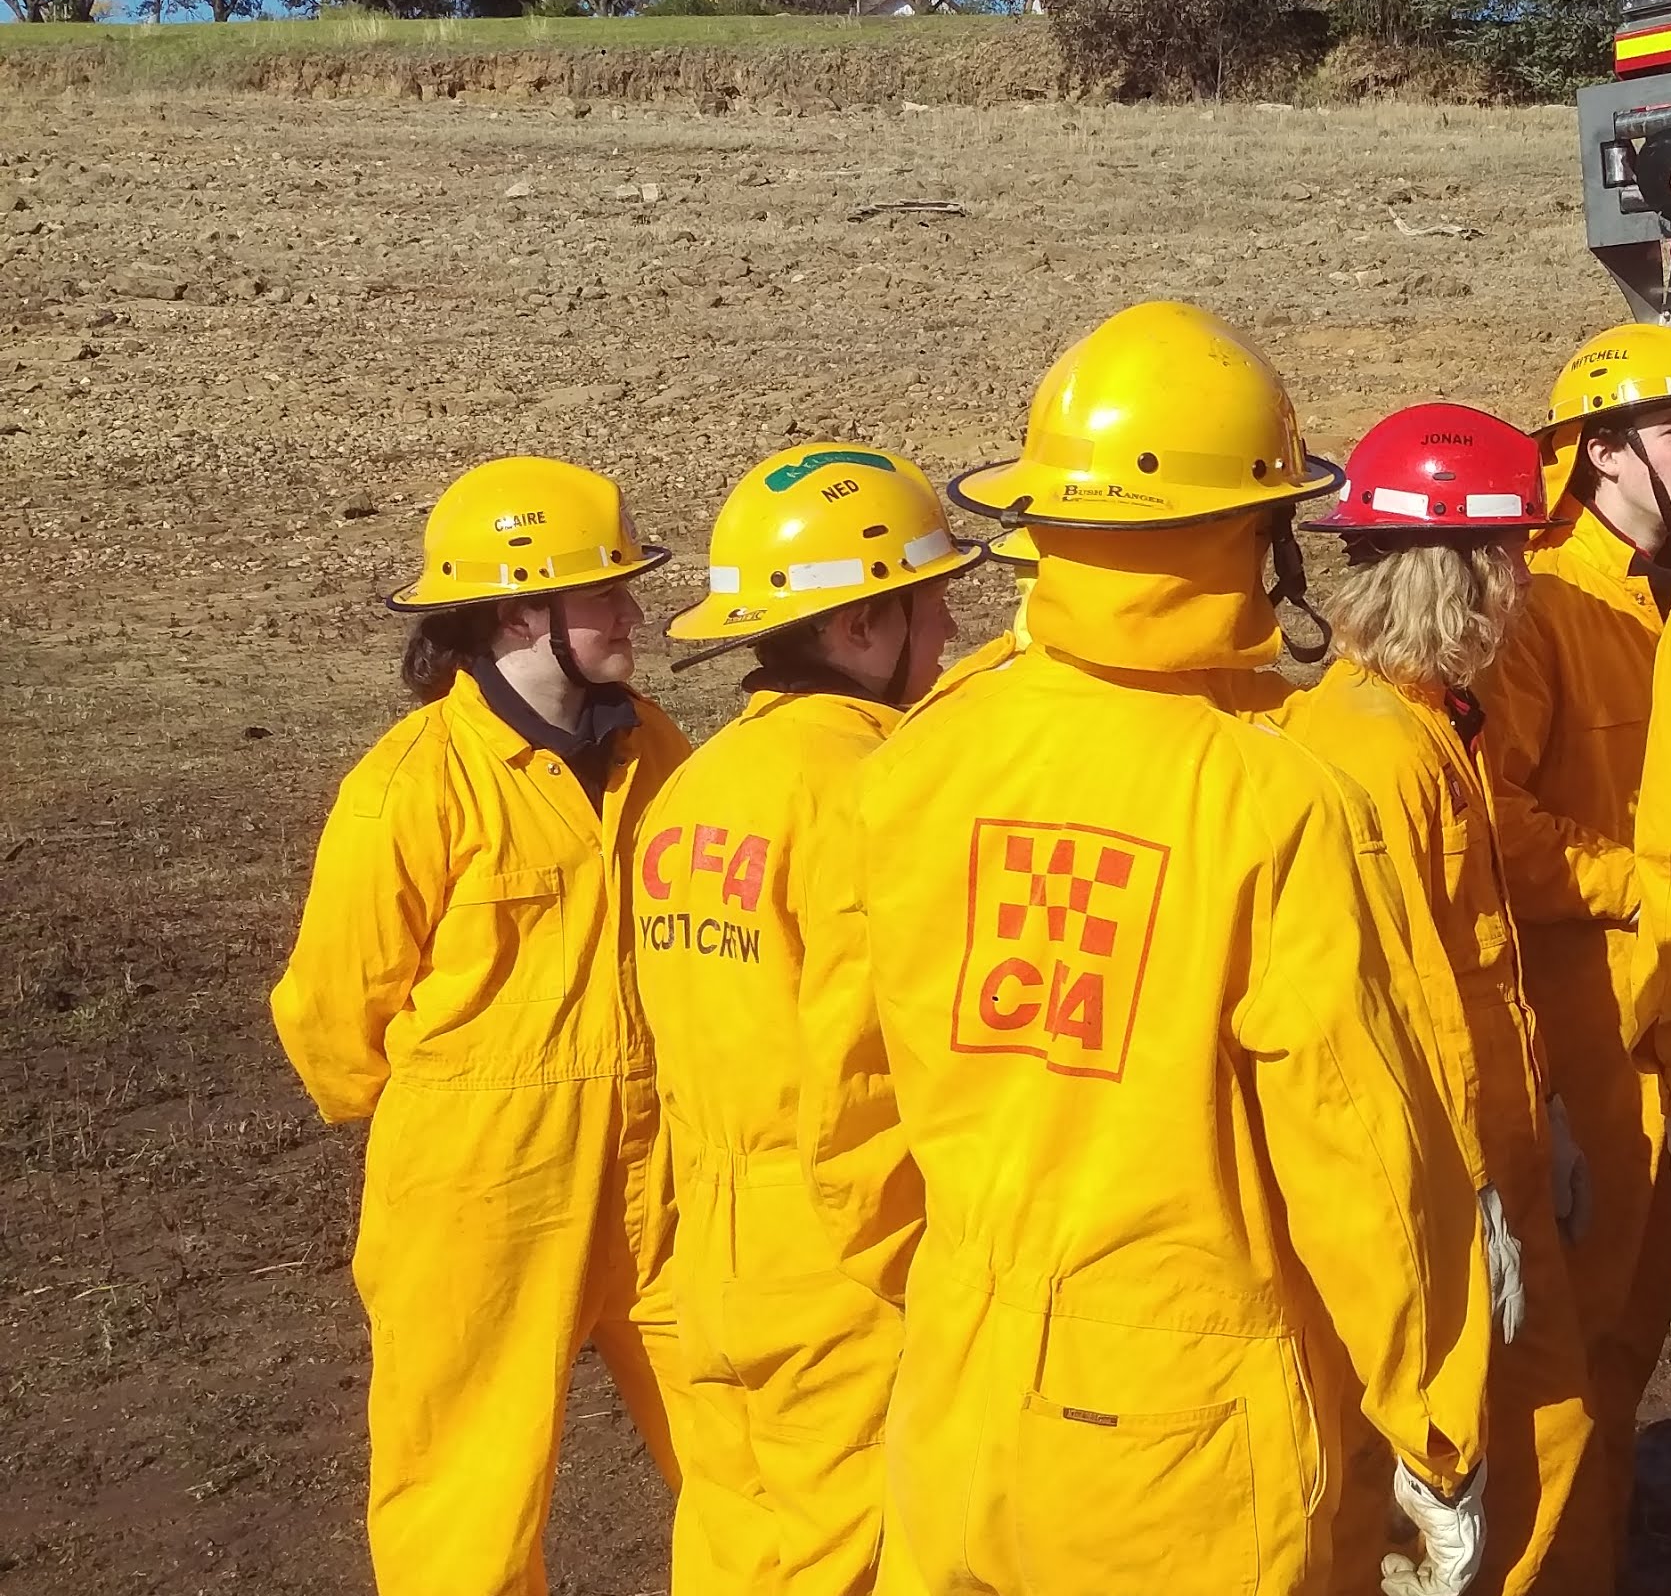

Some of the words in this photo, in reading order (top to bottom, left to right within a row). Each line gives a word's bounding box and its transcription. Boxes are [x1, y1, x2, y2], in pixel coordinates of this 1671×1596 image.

[1571, 349, 1629, 373] MITCHELL
[1420, 432, 1473, 447] JONAH
[820, 479, 861, 504] NED
[1106, 484, 1165, 505] RANGER
[494, 510, 548, 532] CLAIRE
[642, 824, 772, 912] CFA
